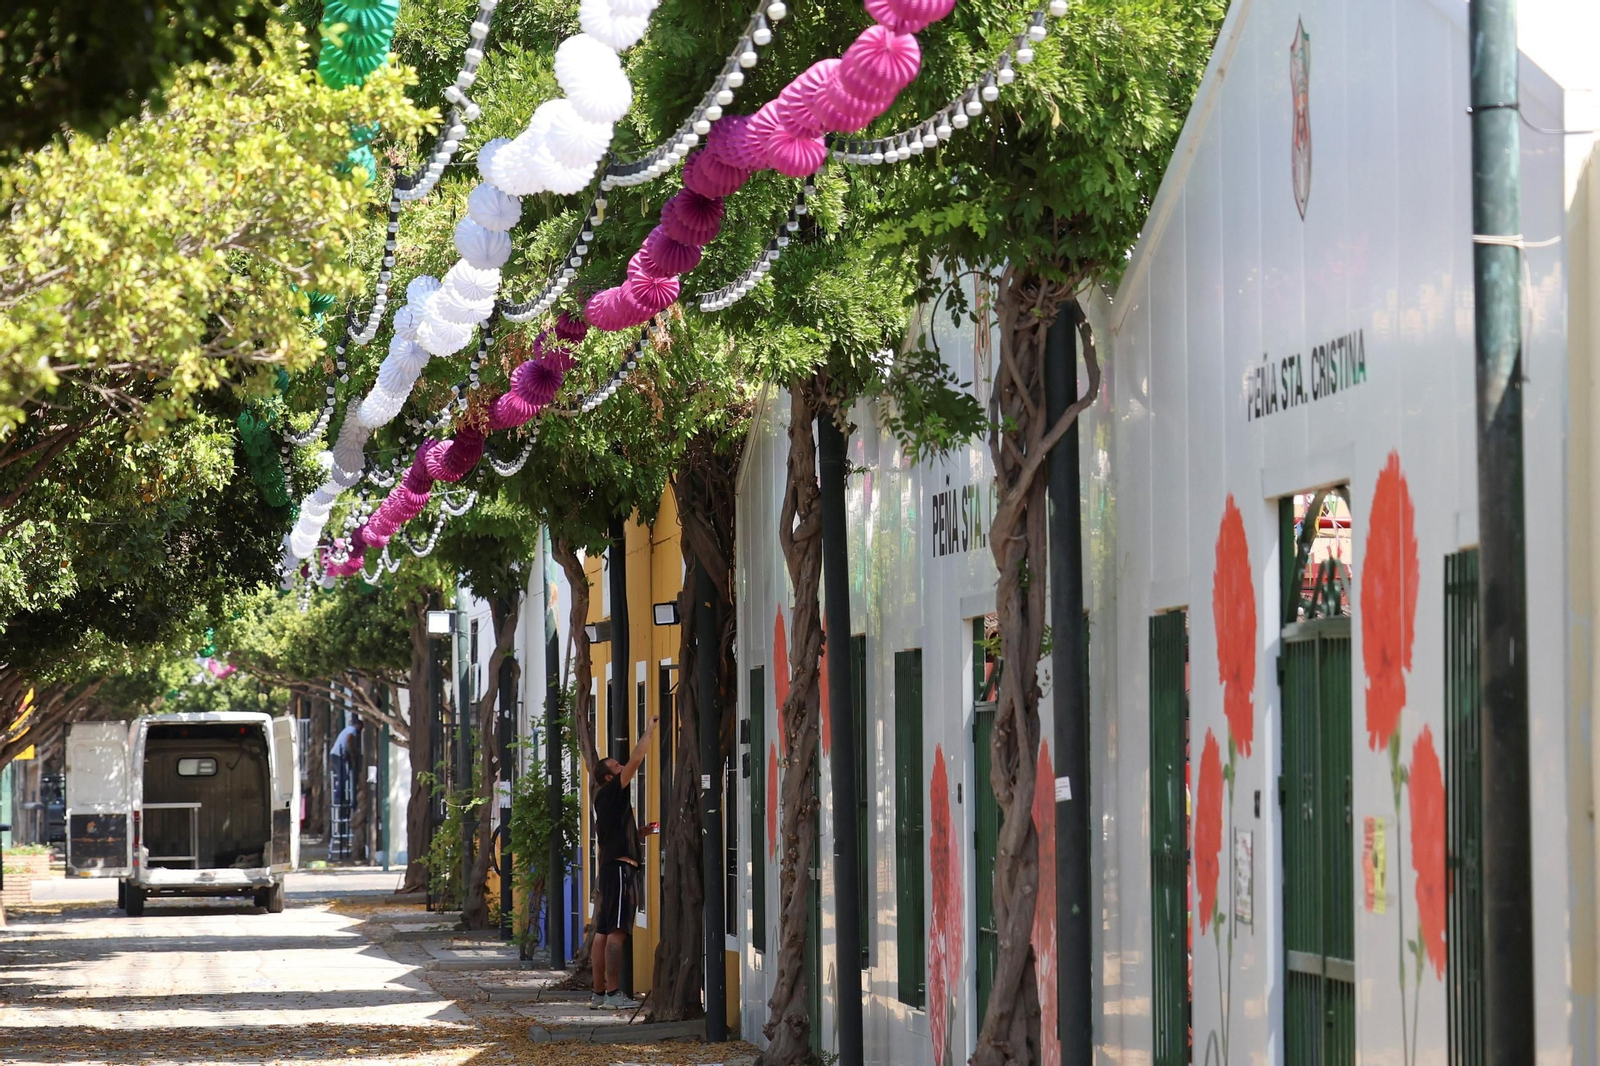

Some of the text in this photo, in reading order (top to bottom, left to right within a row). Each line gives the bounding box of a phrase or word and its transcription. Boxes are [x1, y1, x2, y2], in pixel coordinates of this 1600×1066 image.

[1281, 354, 1308, 410] STA.
[1311, 328, 1367, 401] CRISTINA
[932, 473, 959, 557] PEÑA
[962, 483, 986, 552] STA.
